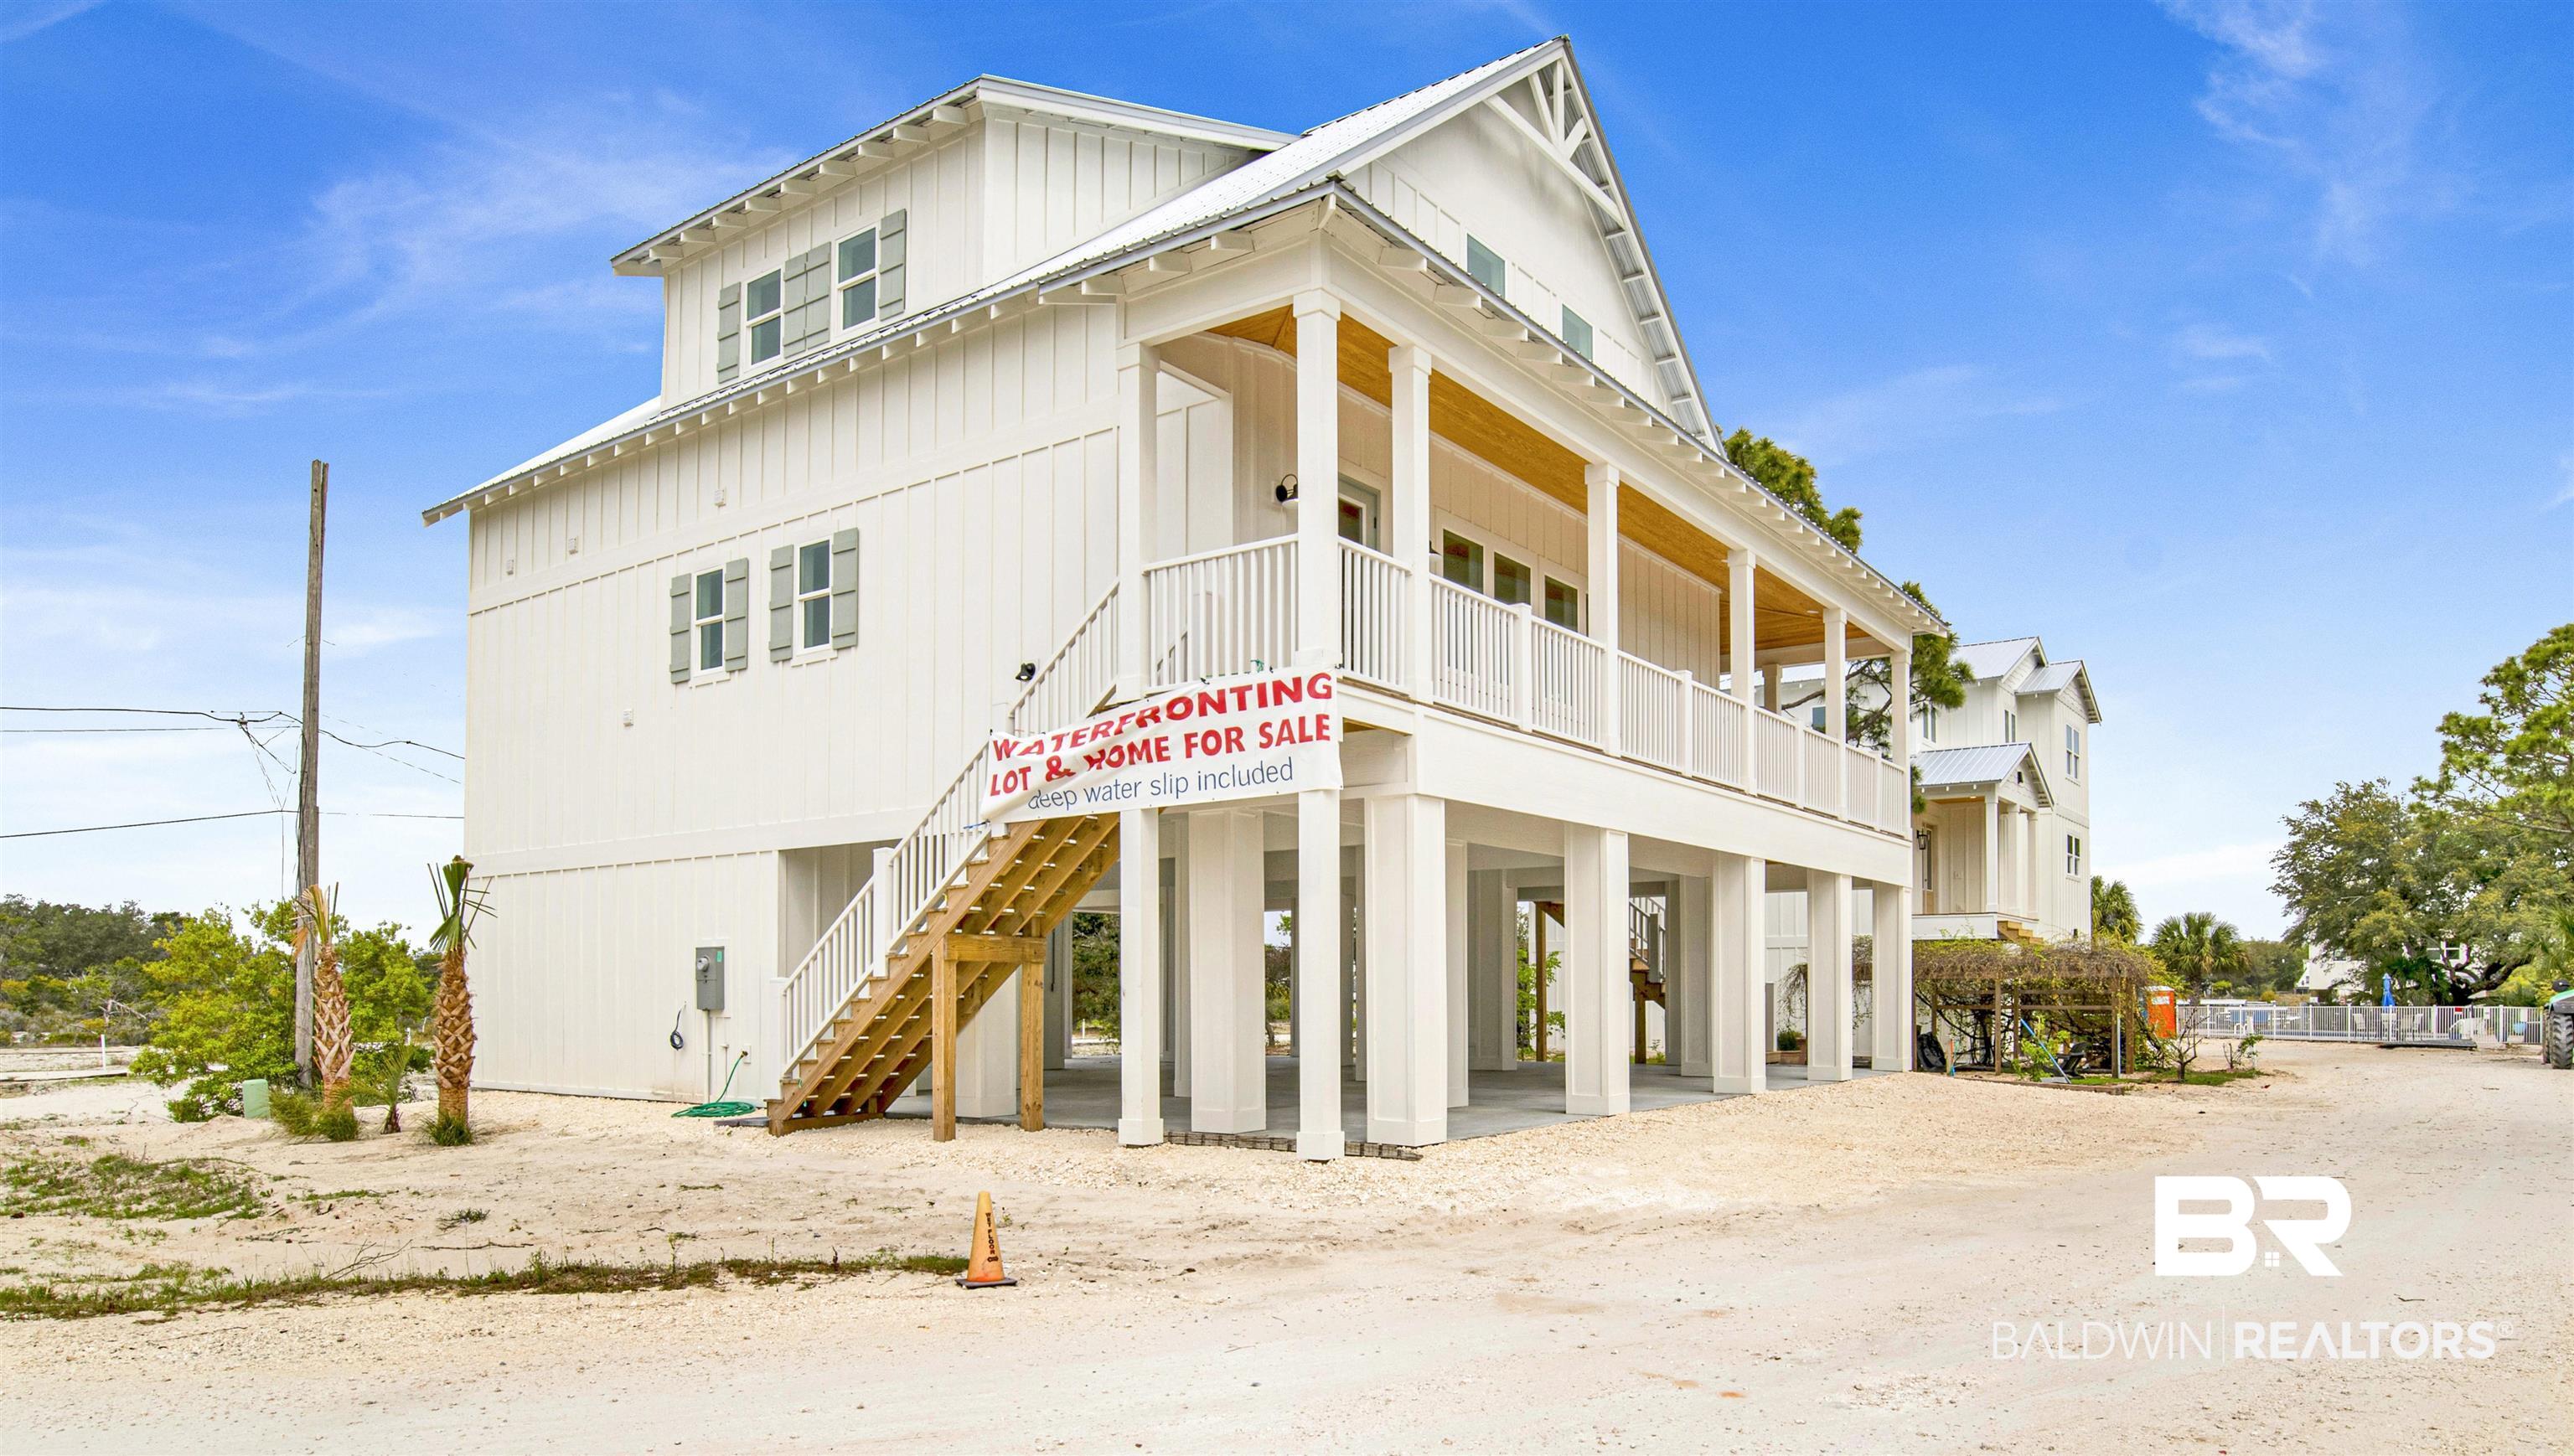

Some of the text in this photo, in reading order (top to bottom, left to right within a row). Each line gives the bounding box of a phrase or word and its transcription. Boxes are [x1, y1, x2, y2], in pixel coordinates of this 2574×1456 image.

[993, 673, 1332, 762] WATERFRONTING
[990, 713, 1331, 797] LOT & HOME FOR SALE
[1027, 756, 1294, 811] deep water slip included
[987, 1228, 995, 1255] FLOOR
